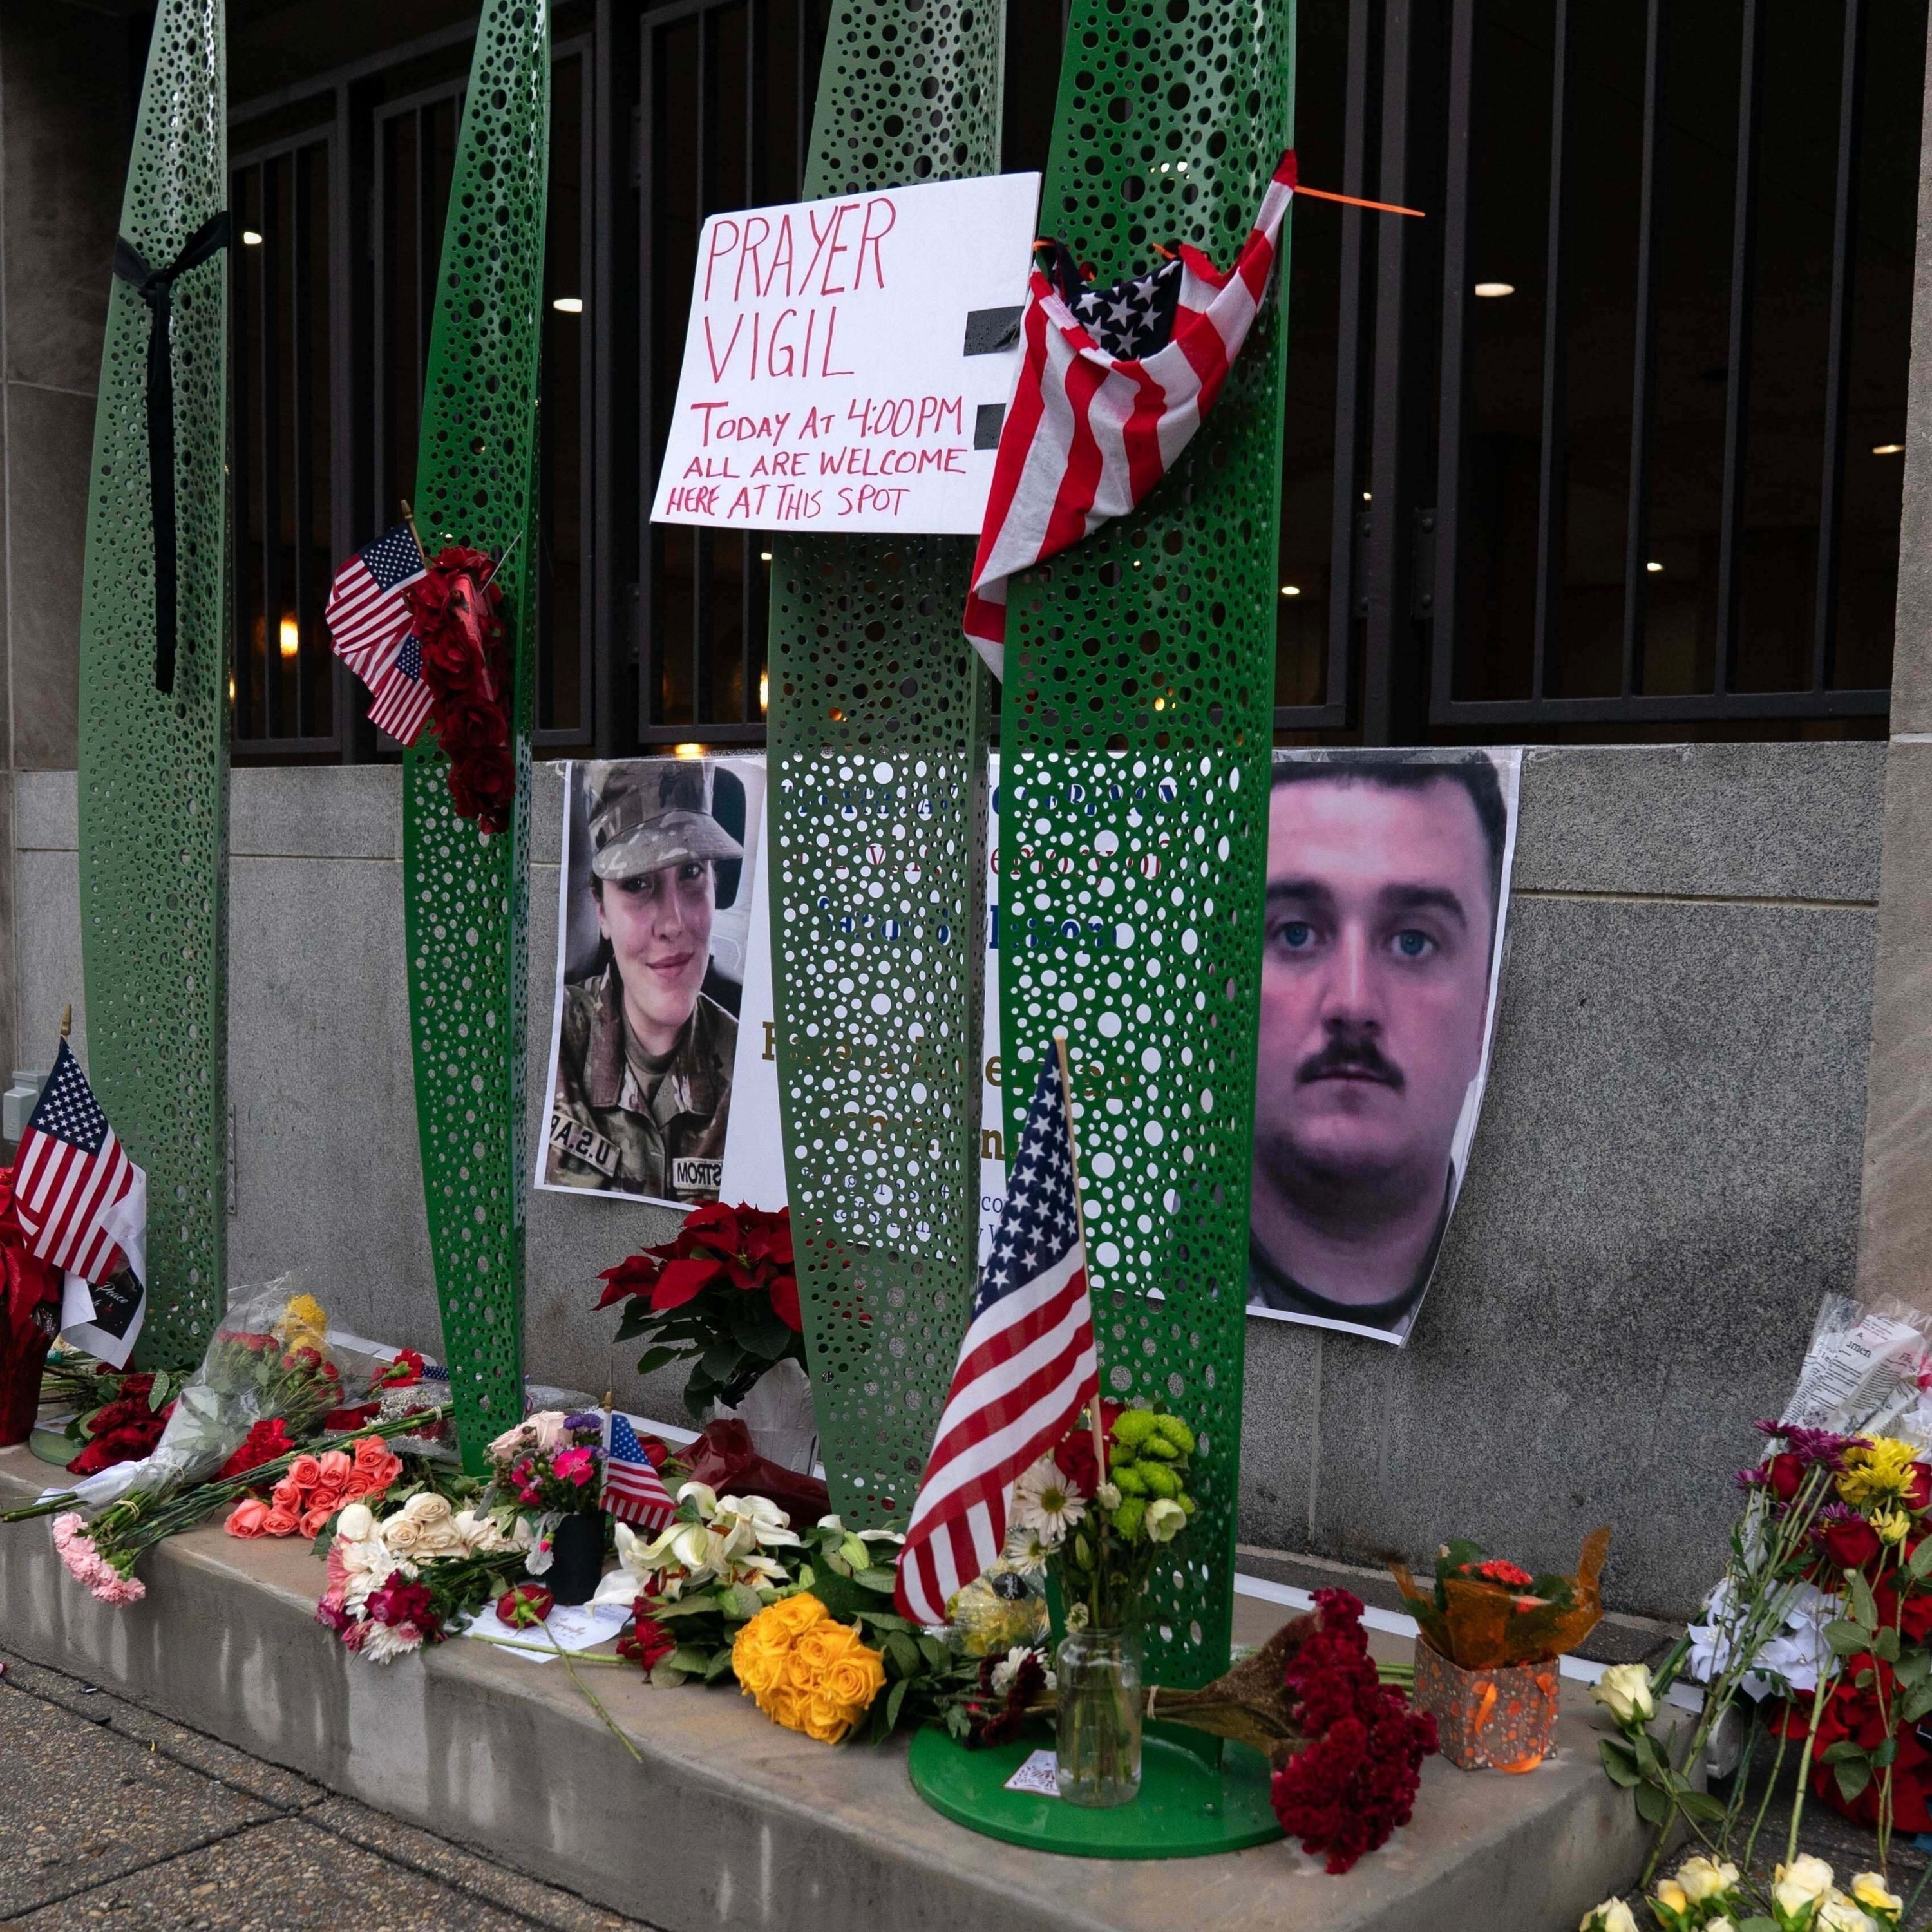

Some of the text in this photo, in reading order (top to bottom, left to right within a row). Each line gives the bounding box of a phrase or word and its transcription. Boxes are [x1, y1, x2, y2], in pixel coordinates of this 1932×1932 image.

[703, 196, 897, 301] PRAYER
[703, 305, 855, 384] VIGIL
[690, 400, 791, 447] TODAY
[798, 406, 835, 440] AT
[683, 446, 968, 479] ALL ARE WELCOME
[665, 482, 911, 520] HERE AT THIS SPOT
